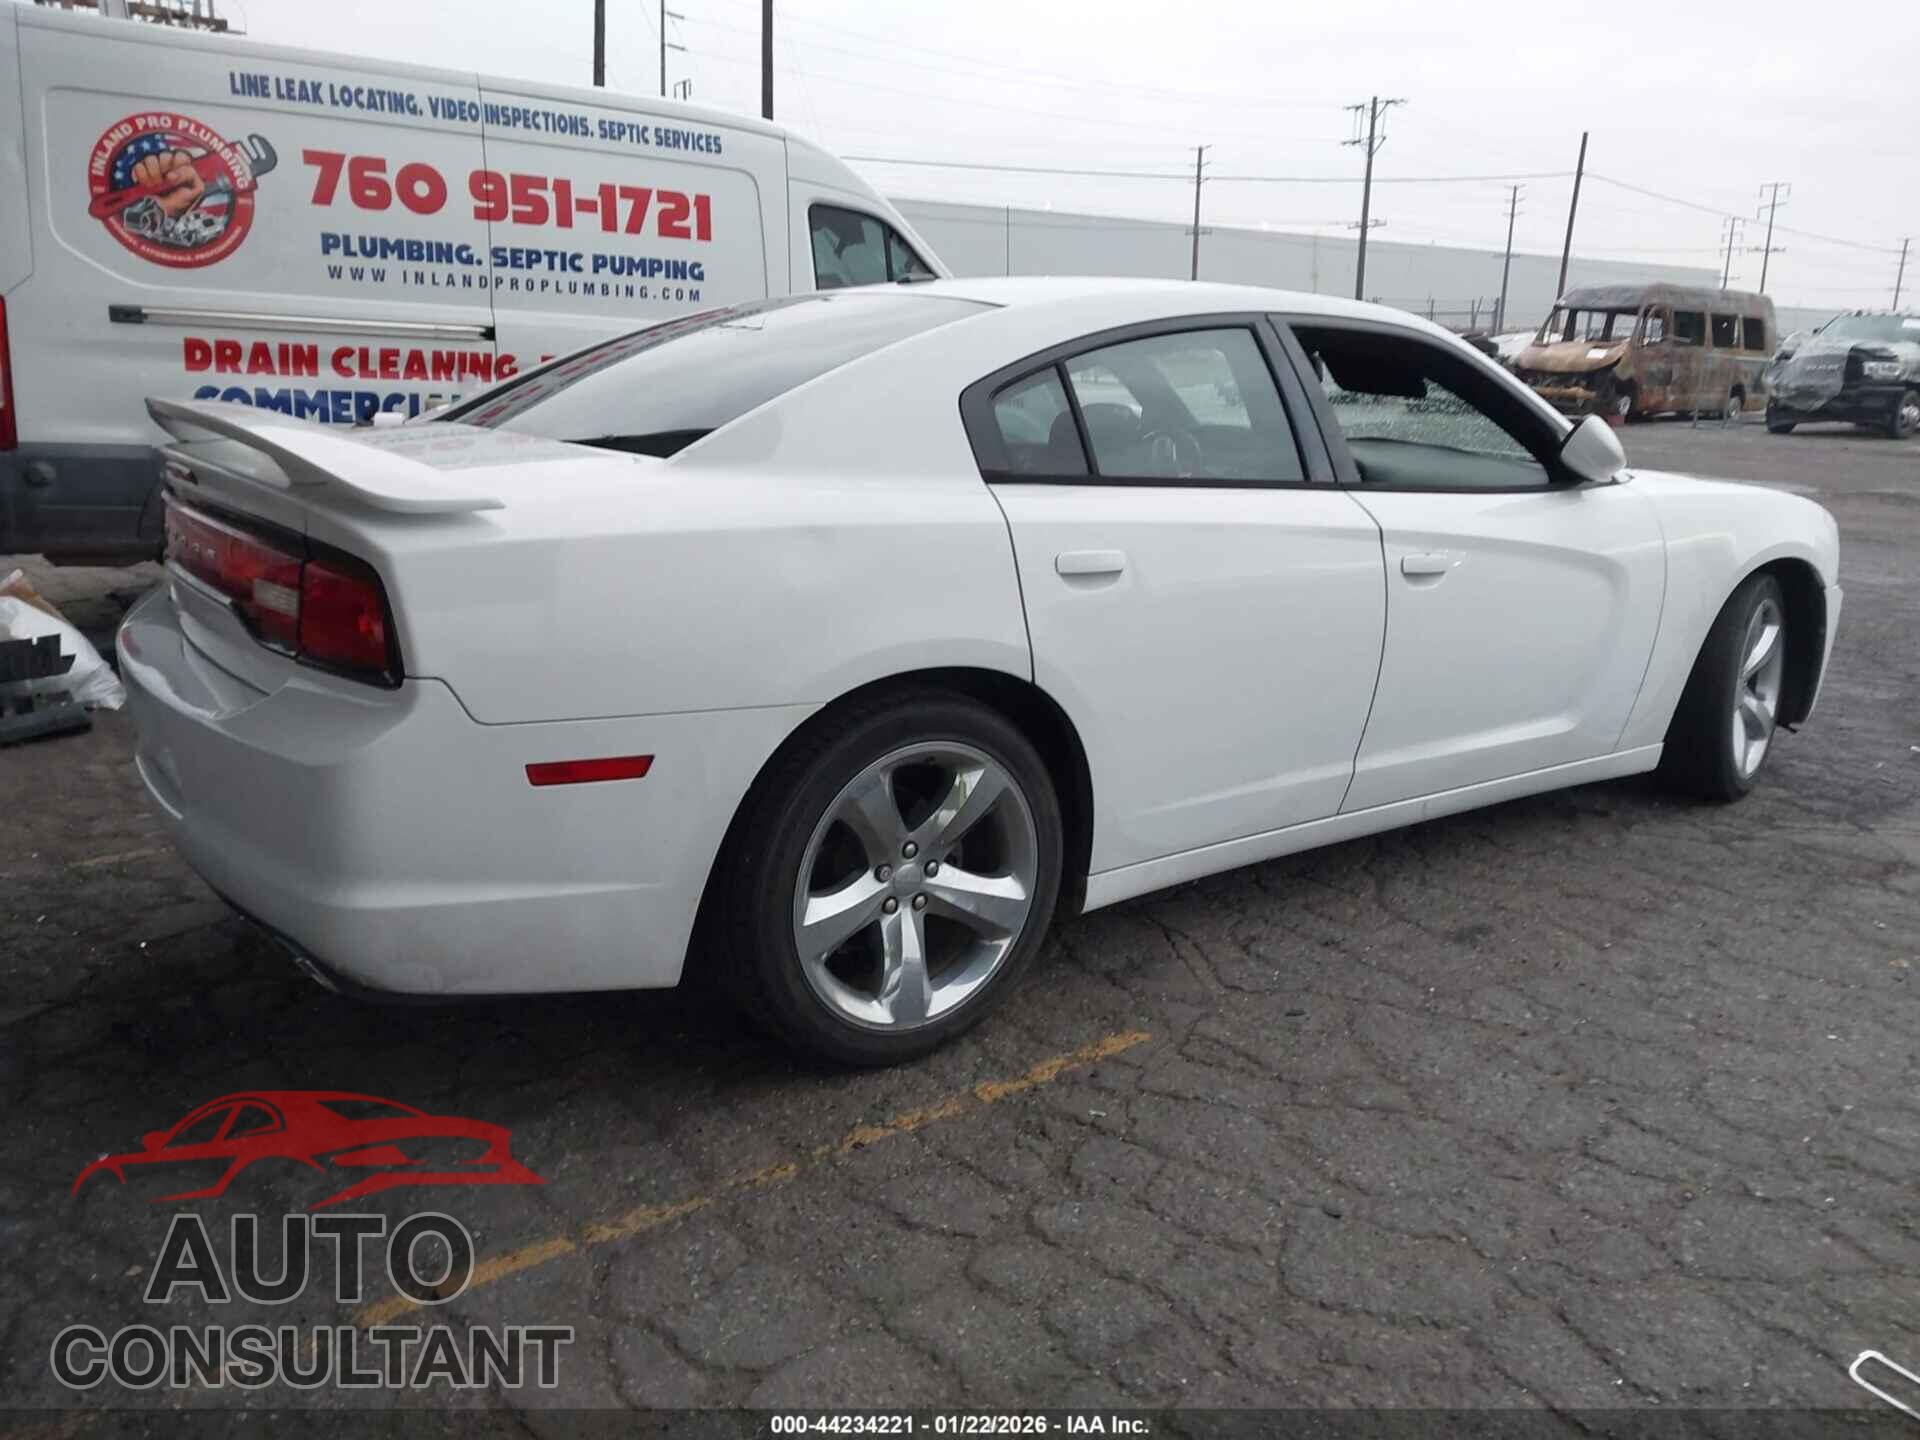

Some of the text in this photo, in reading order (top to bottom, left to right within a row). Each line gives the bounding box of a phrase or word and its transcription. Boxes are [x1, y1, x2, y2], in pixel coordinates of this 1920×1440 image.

[229, 71, 270, 99] LINE
[275, 77, 324, 105] LEAK
[427, 96, 480, 123] VIDEO
[599, 119, 649, 146] SEPTIC
[654, 127, 722, 155] SERVICES
[92, 115, 249, 189] INLAND PRO PLUMBING
[302, 149, 712, 242] 760 951-1721
[490, 247, 584, 273] SEPTIC
[592, 253, 705, 282] PUMPING
[183, 337, 518, 383] DRAIN CLEANING
[194, 385, 461, 423] OMMERCI
